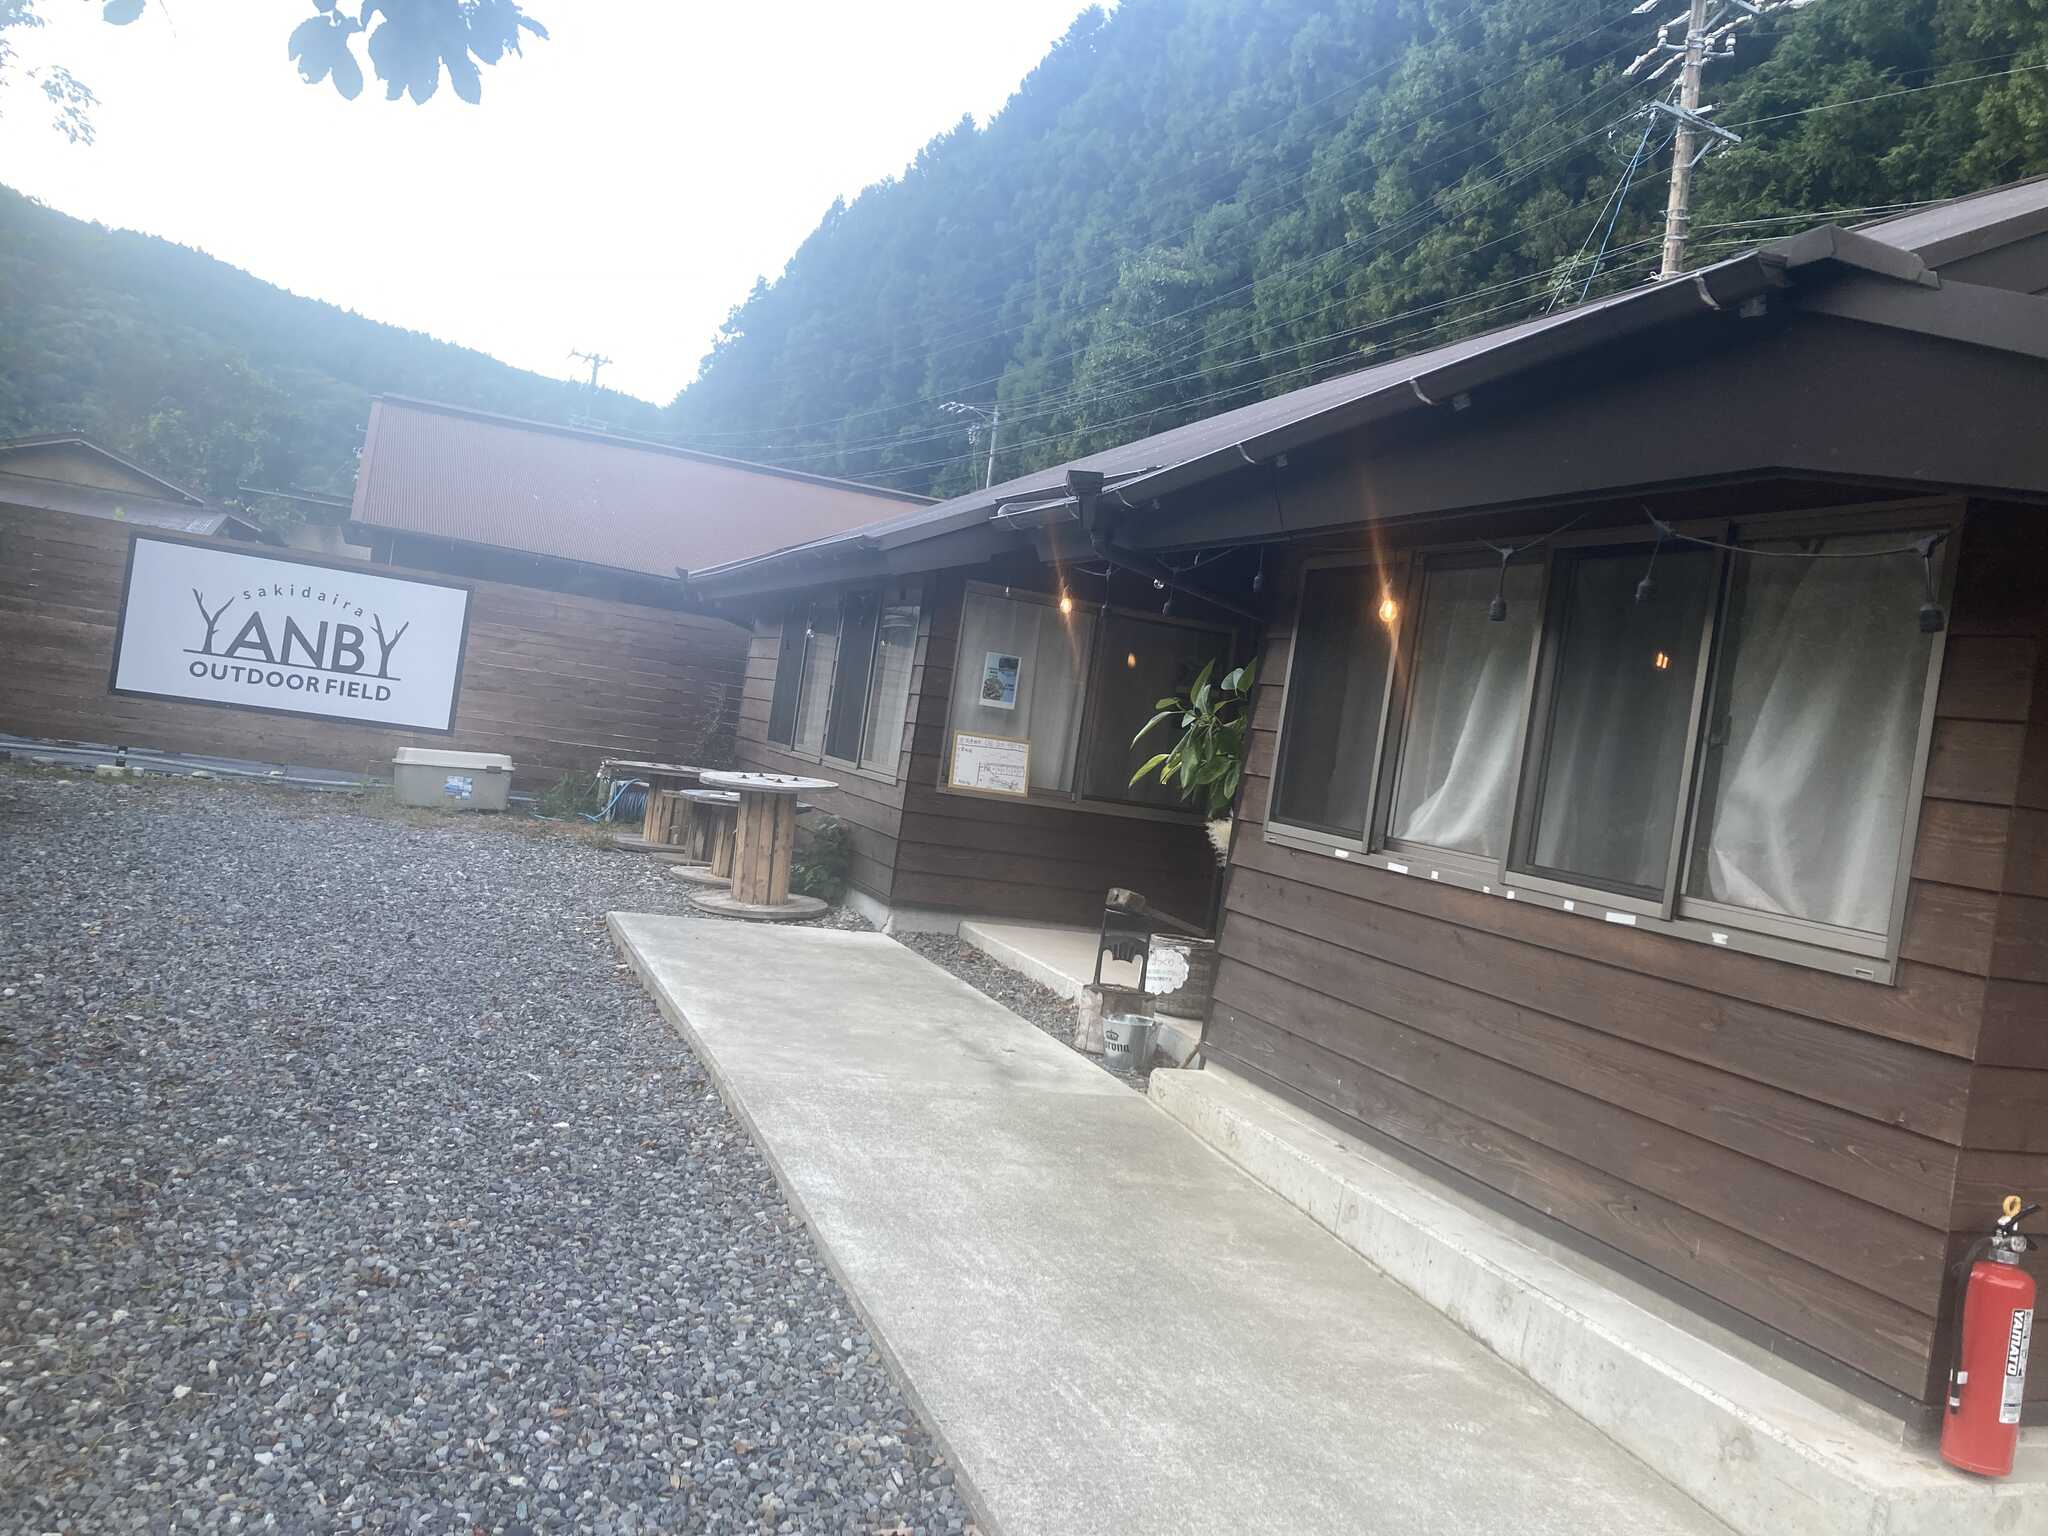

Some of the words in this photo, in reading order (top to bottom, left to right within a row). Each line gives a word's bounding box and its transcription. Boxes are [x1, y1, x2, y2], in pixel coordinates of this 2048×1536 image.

[243, 584, 364, 617] sakidaira
[192, 587, 410, 678] YANBY
[189, 660, 320, 693] OUTDOOR
[325, 678, 391, 702] FIELD
